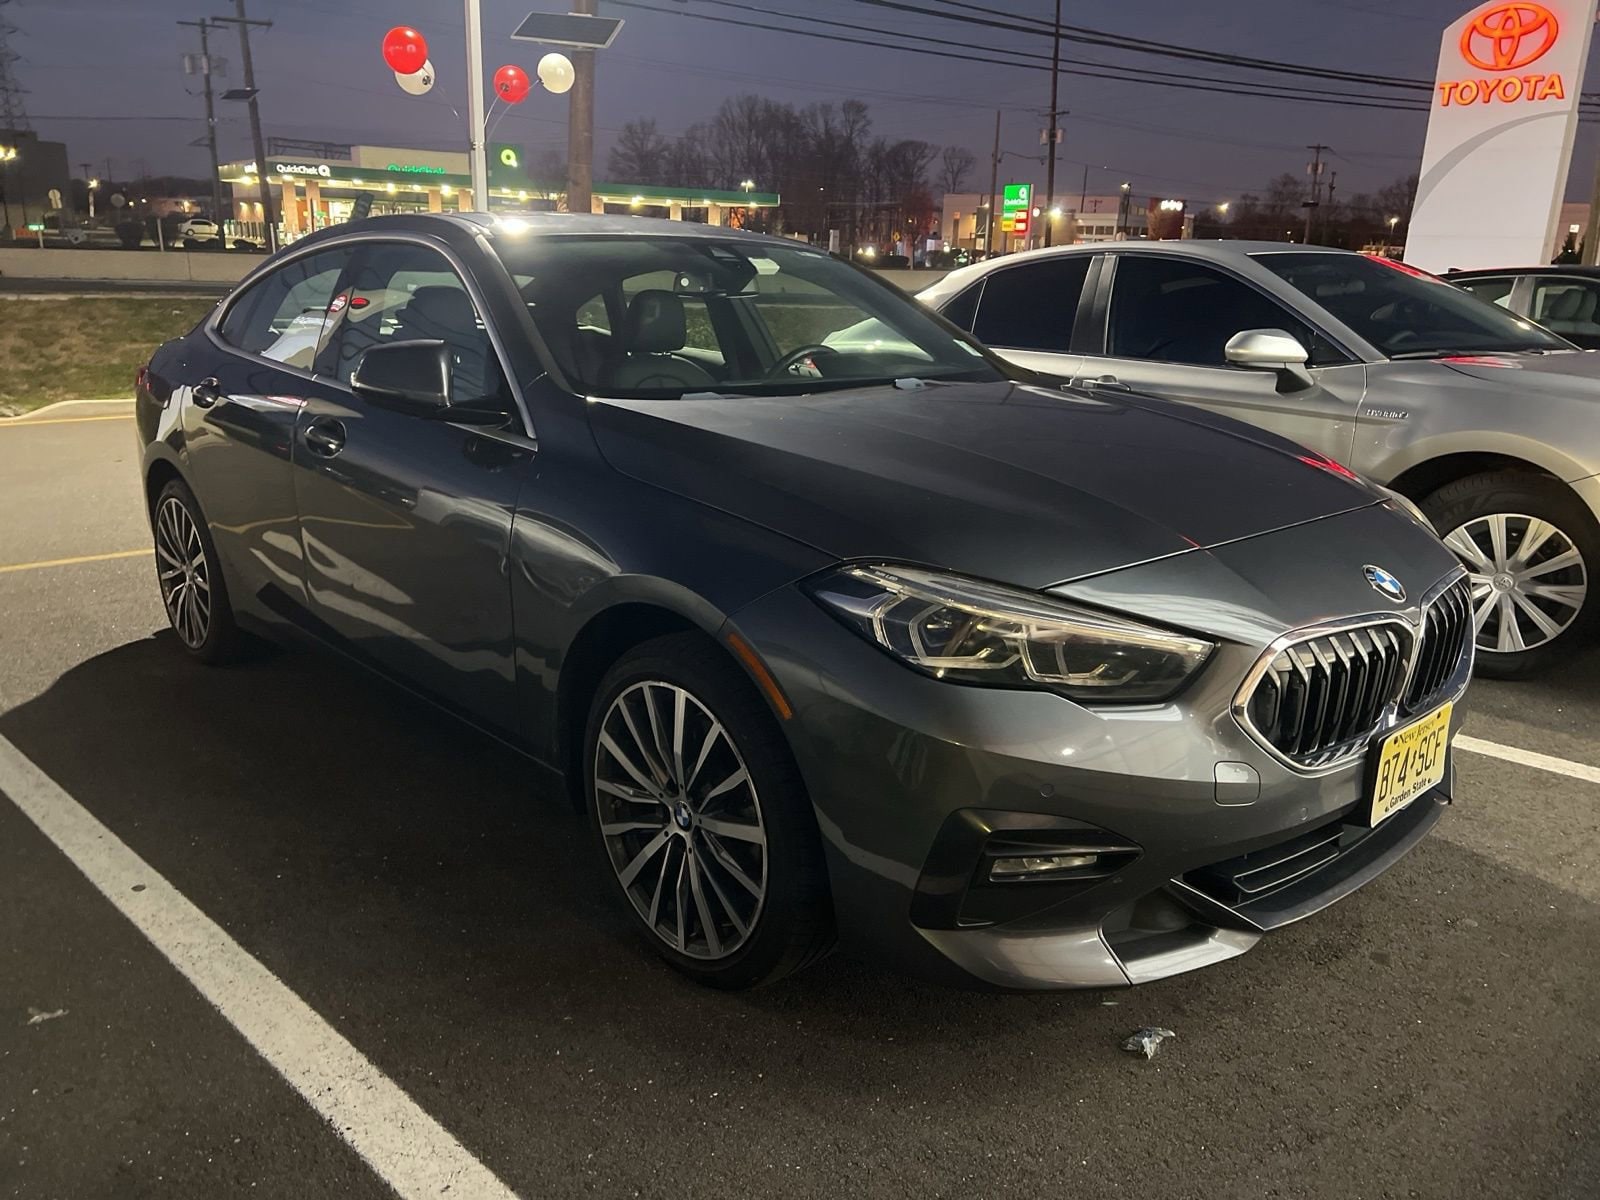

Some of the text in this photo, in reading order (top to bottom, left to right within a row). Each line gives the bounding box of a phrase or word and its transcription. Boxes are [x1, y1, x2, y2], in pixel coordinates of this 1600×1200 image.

[1439, 74, 1564, 106] TOYOTA
[276, 163, 319, 175] QuickChek
[1389, 778, 1427, 808] Garden State
